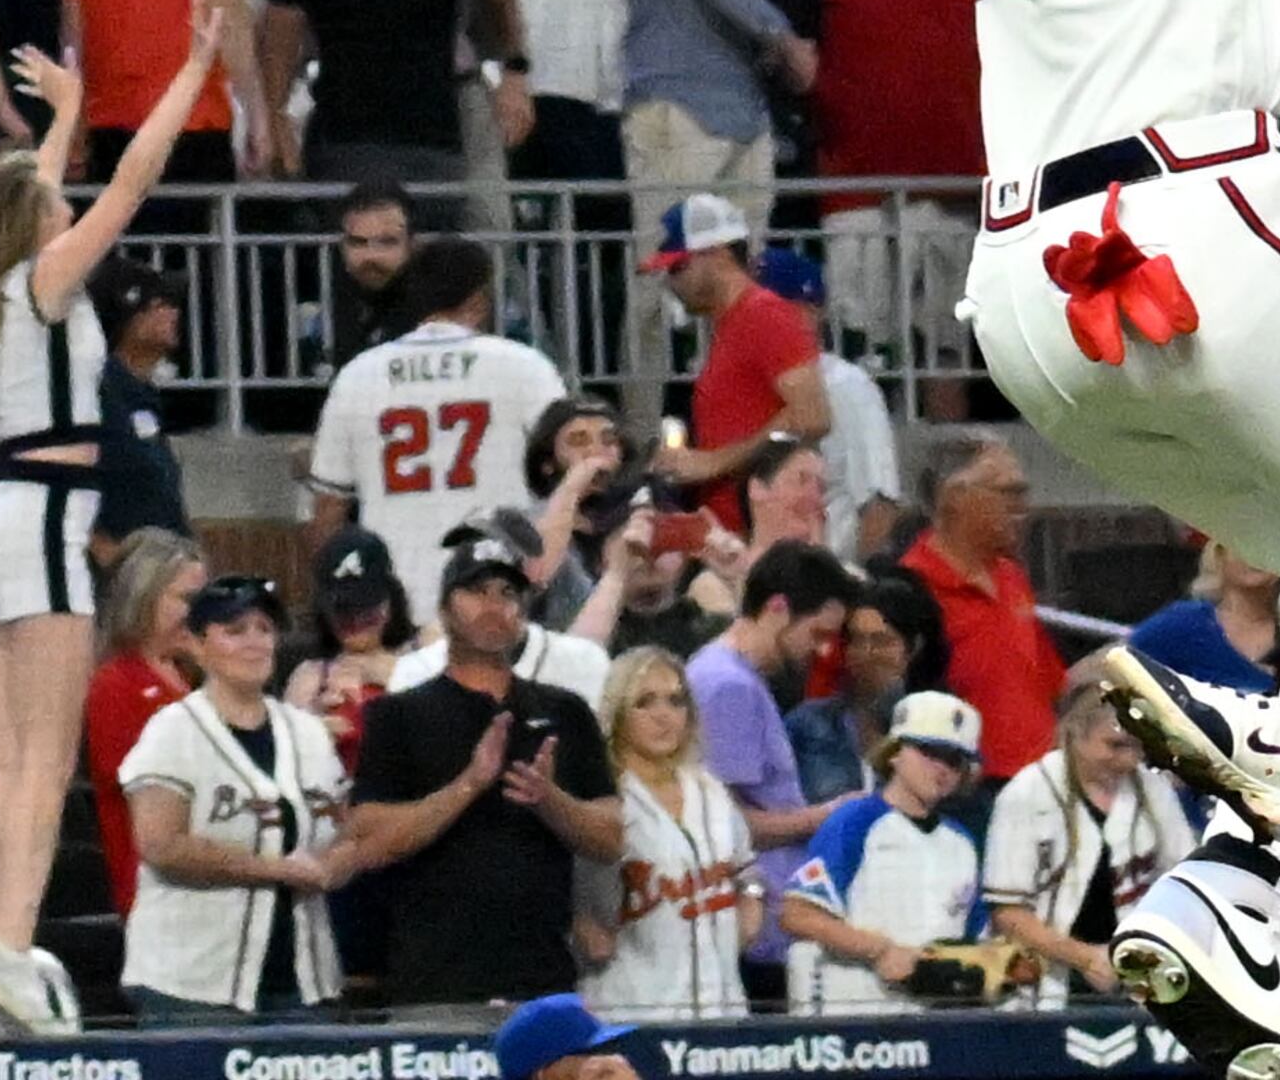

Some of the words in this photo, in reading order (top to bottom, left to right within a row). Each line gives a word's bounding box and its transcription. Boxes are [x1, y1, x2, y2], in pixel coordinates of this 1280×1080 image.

[388, 351, 479, 387] RILEY
[378, 399, 492, 495] 27
[224, 1046, 382, 1080] Compact
[391, 1041, 502, 1080] Equip
[661, 1036, 930, 1077] YanmarUS.com
